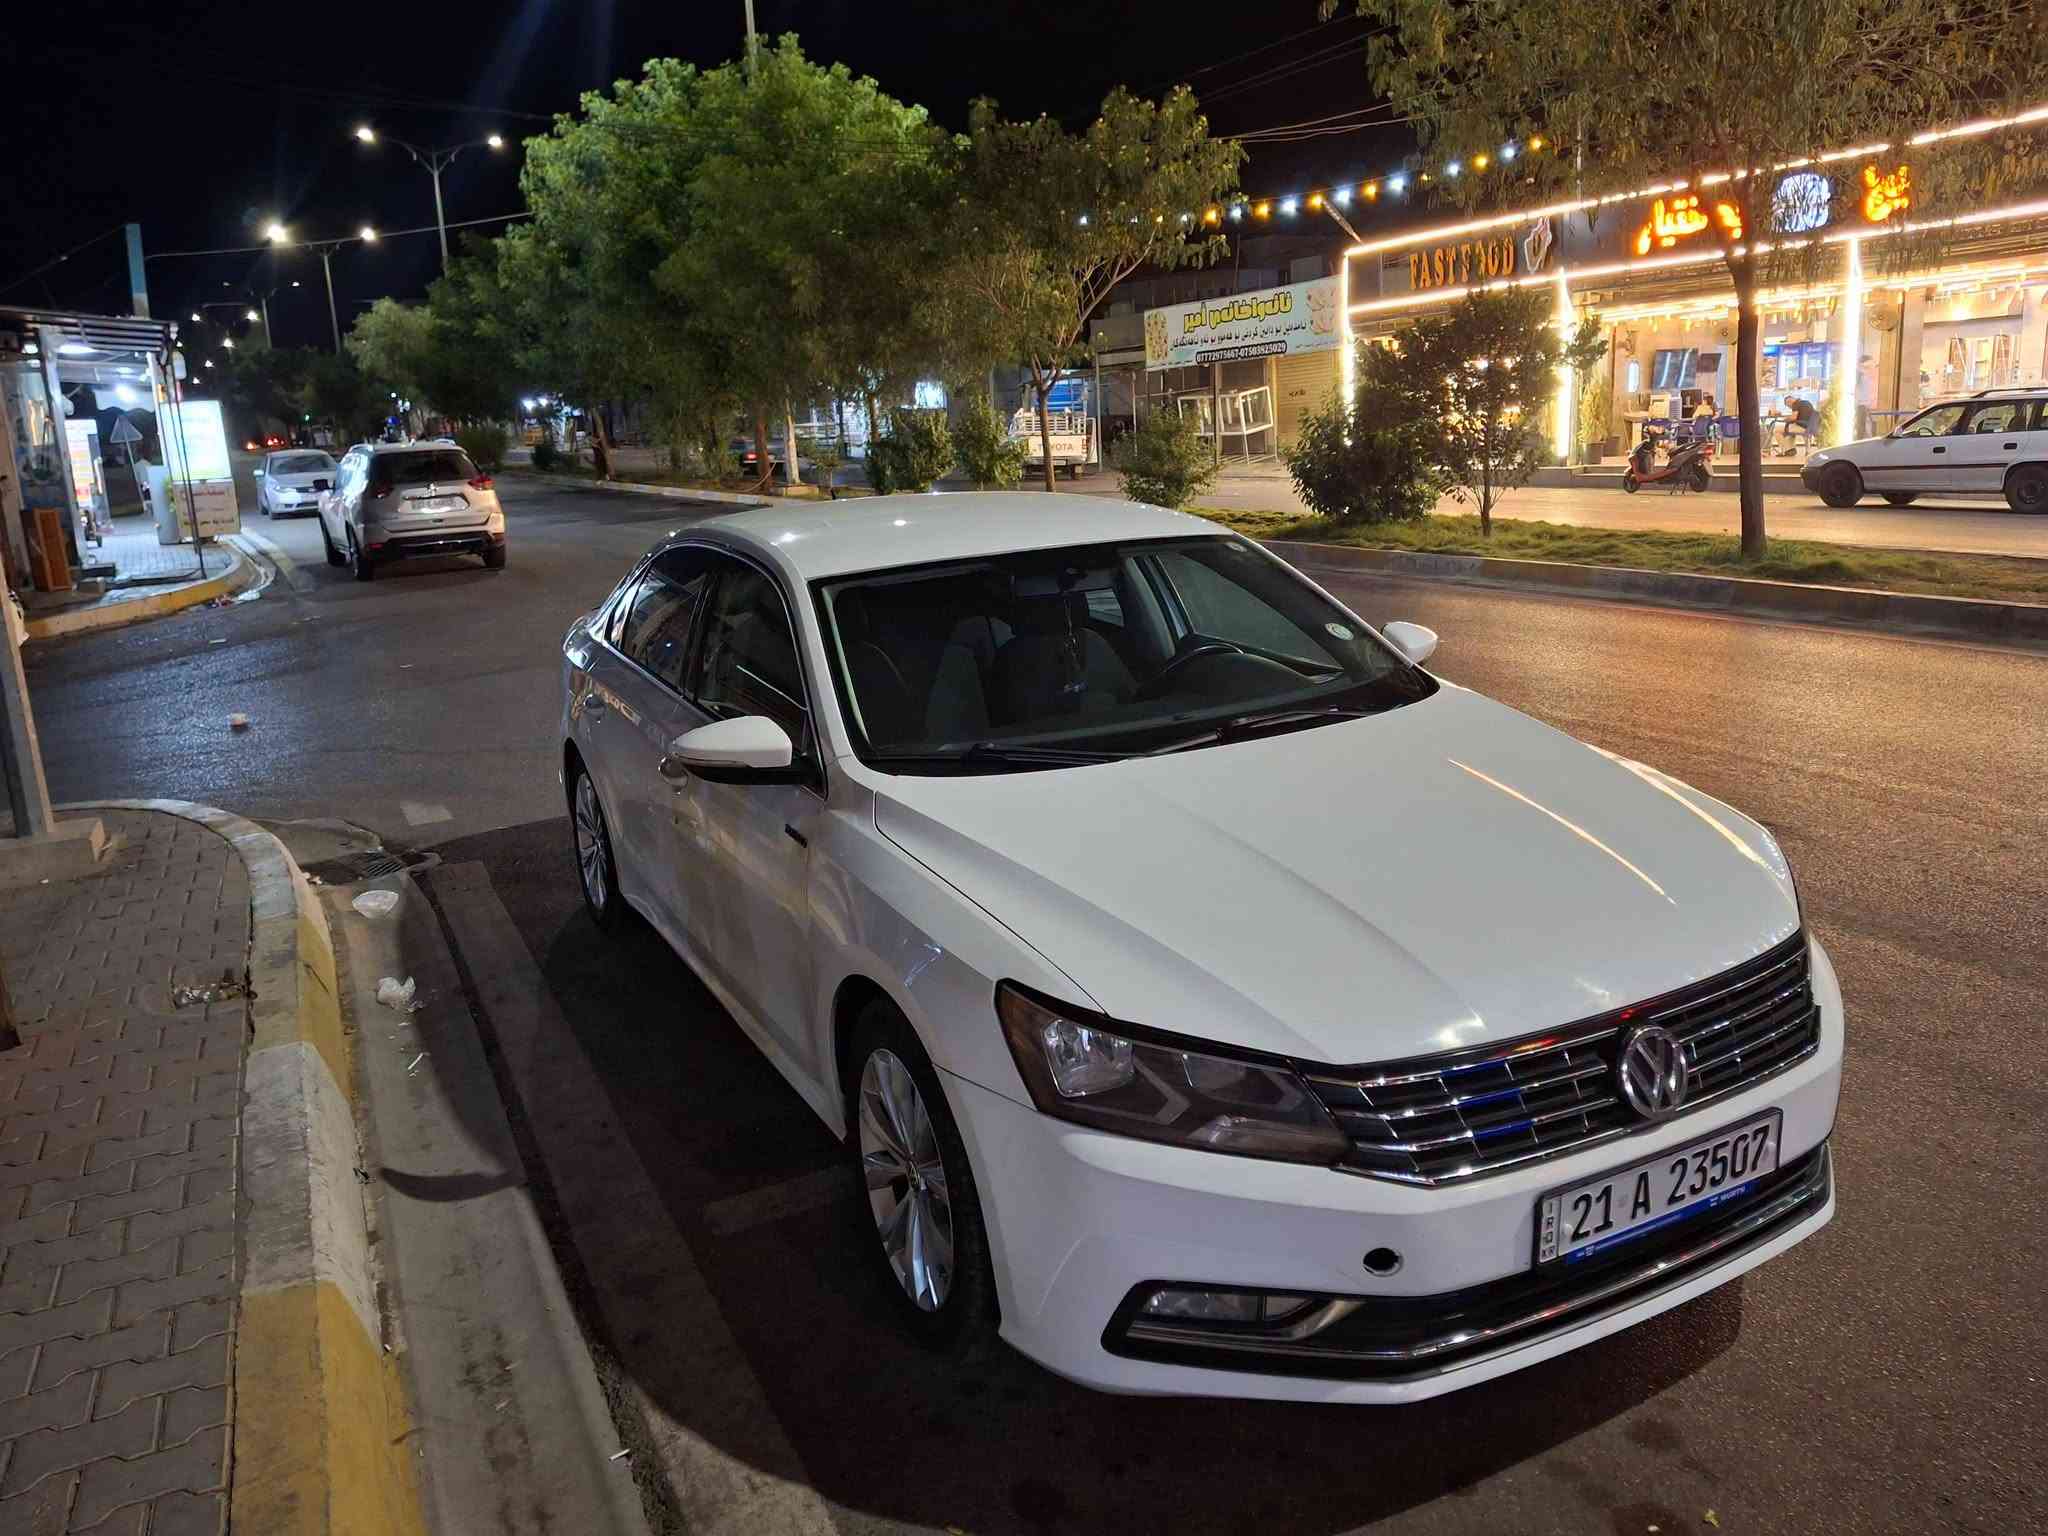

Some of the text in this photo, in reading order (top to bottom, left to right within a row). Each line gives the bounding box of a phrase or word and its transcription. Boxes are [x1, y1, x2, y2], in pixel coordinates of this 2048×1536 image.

[1409, 243, 1457, 289] FAST
[1570, 1124, 1770, 1243] 21 A 23507
